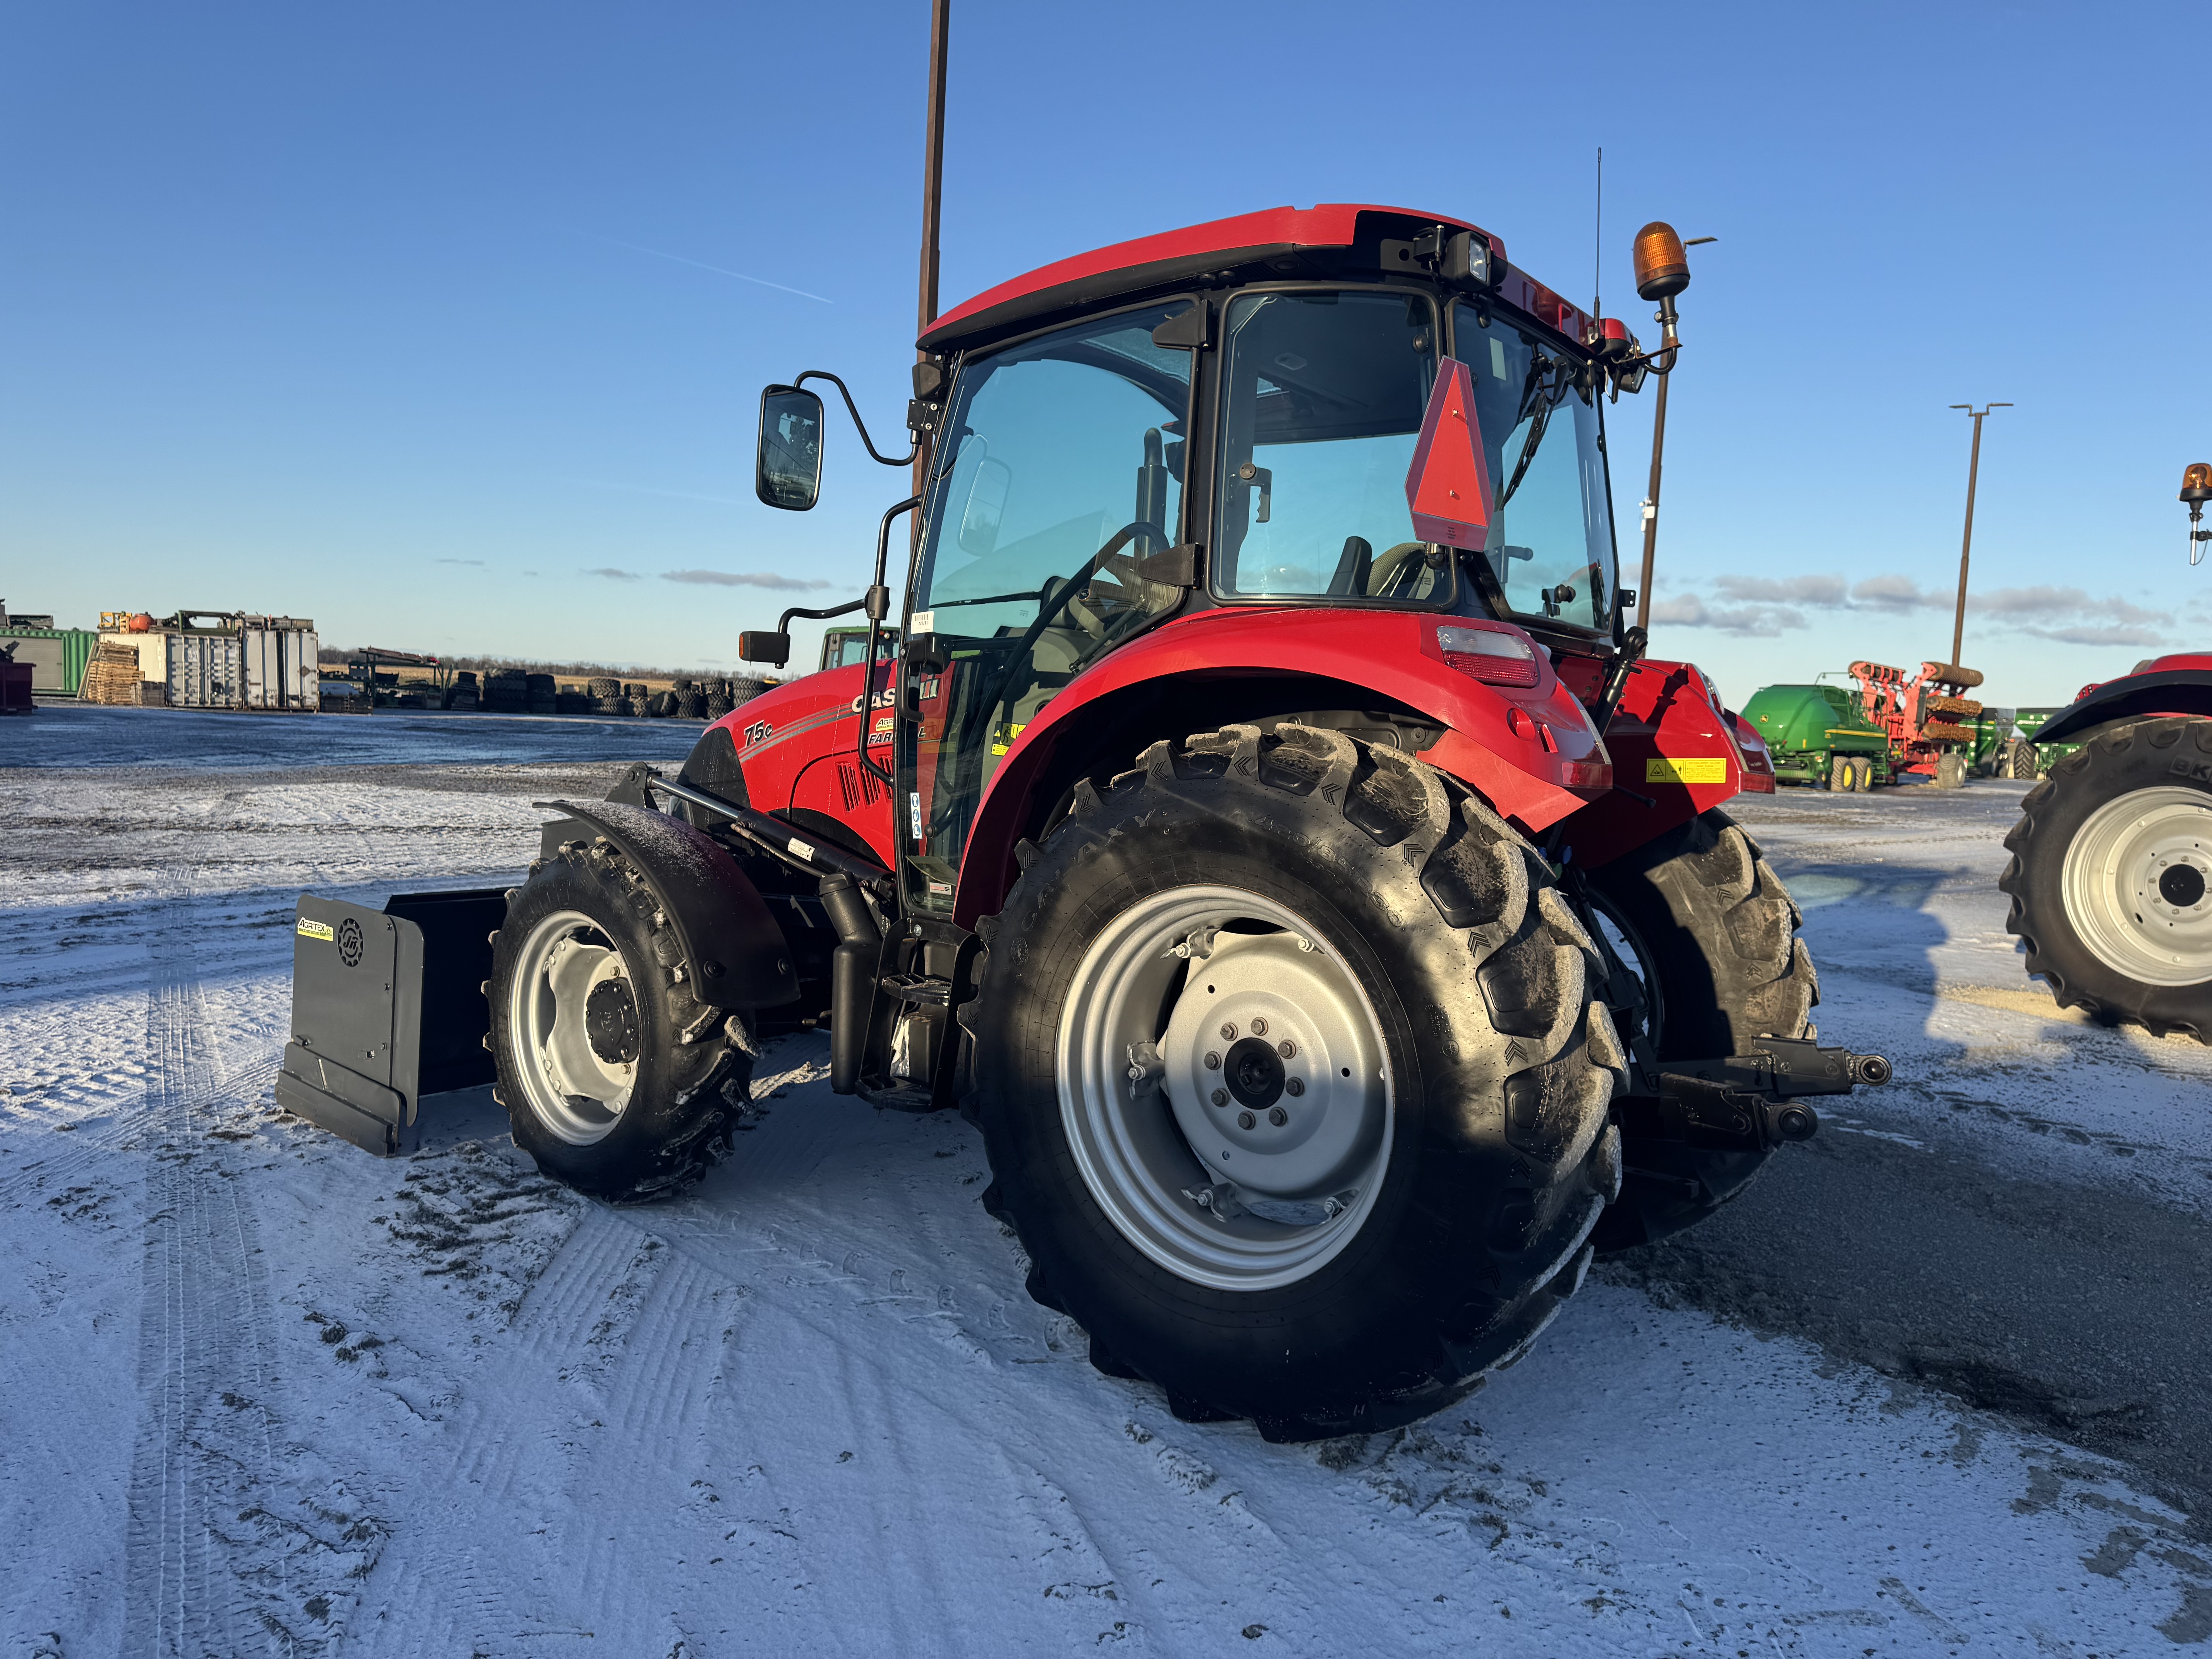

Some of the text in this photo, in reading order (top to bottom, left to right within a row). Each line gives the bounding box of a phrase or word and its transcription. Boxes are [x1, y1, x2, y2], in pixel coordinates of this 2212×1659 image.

[852, 687, 895, 712] CAS
[2171, 757, 2212, 780] BK
[1254, 816, 1404, 927] 420/85R30
[299, 919, 325, 932] AGRITEX
[343, 935, 359, 950] JR
